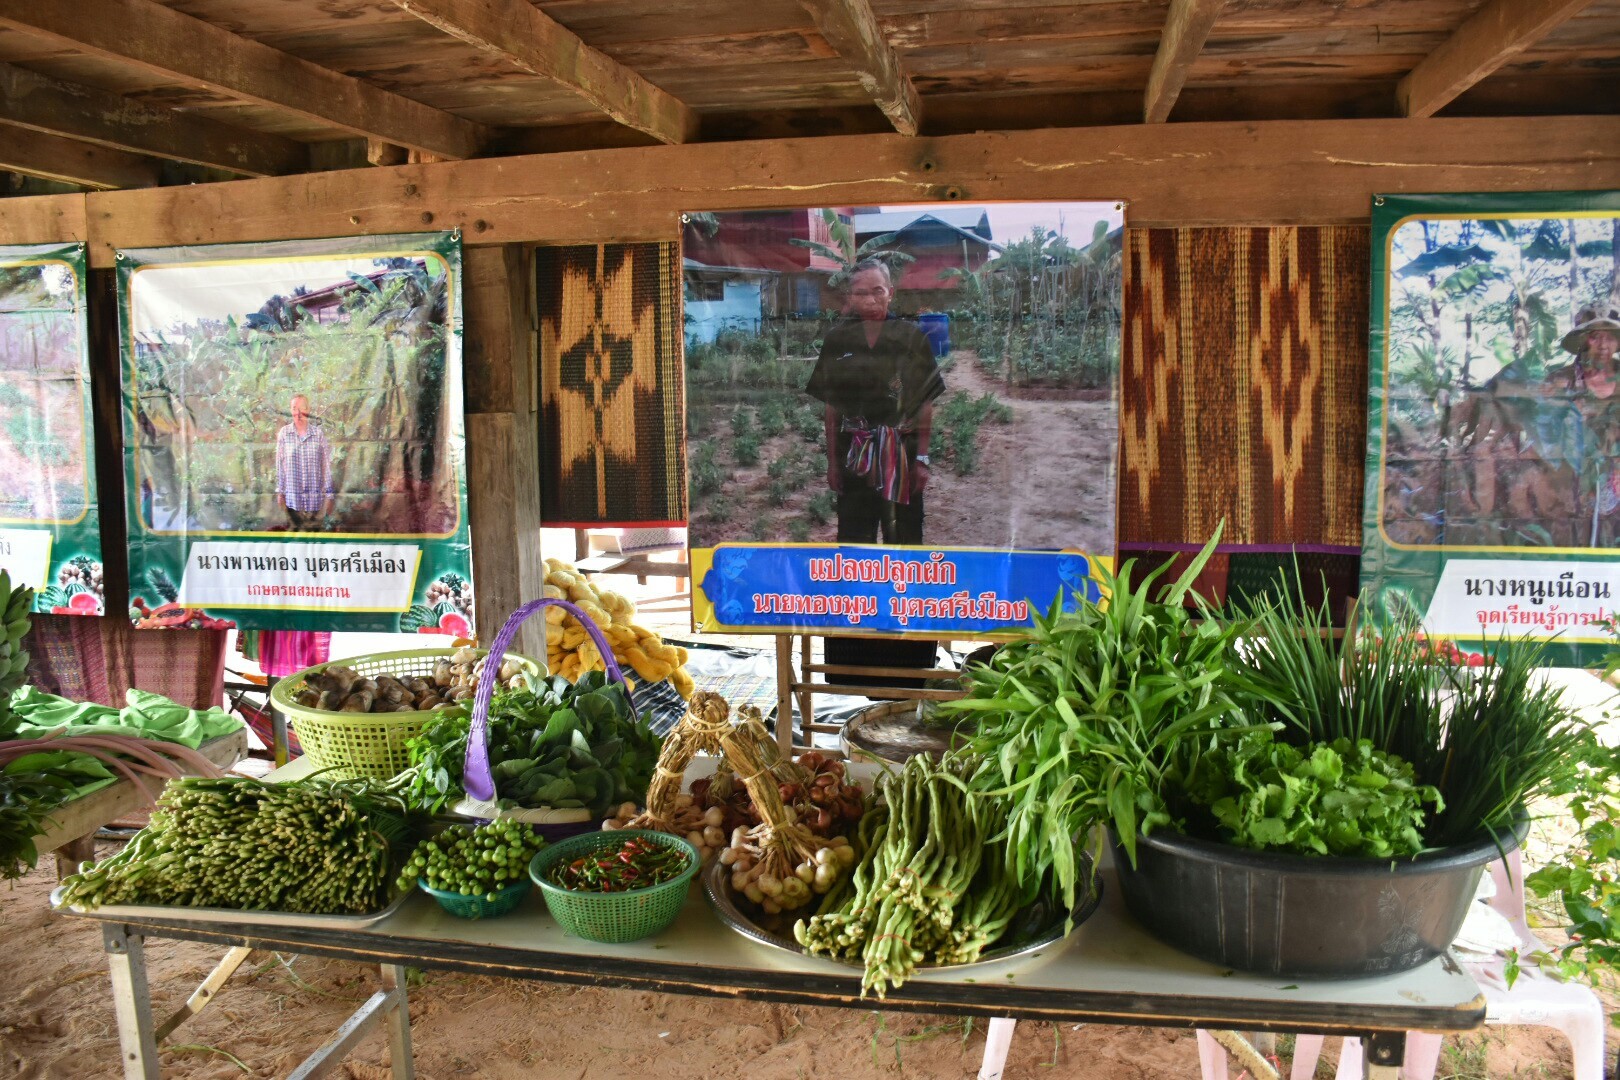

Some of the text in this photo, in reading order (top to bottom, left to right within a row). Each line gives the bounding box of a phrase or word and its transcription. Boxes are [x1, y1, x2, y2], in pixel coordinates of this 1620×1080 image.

[197, 550, 406, 578] นางพานทอง บุตรศรีเมือง
[809, 551, 957, 593] แปลงปลูกผัก
[247, 583, 351, 599] เกษตรผสมผสาน
[1464, 571, 1611, 605] นางหนูเนือน
[752, 590, 1029, 626] นายทองพูน บุตรศรีเมือง
